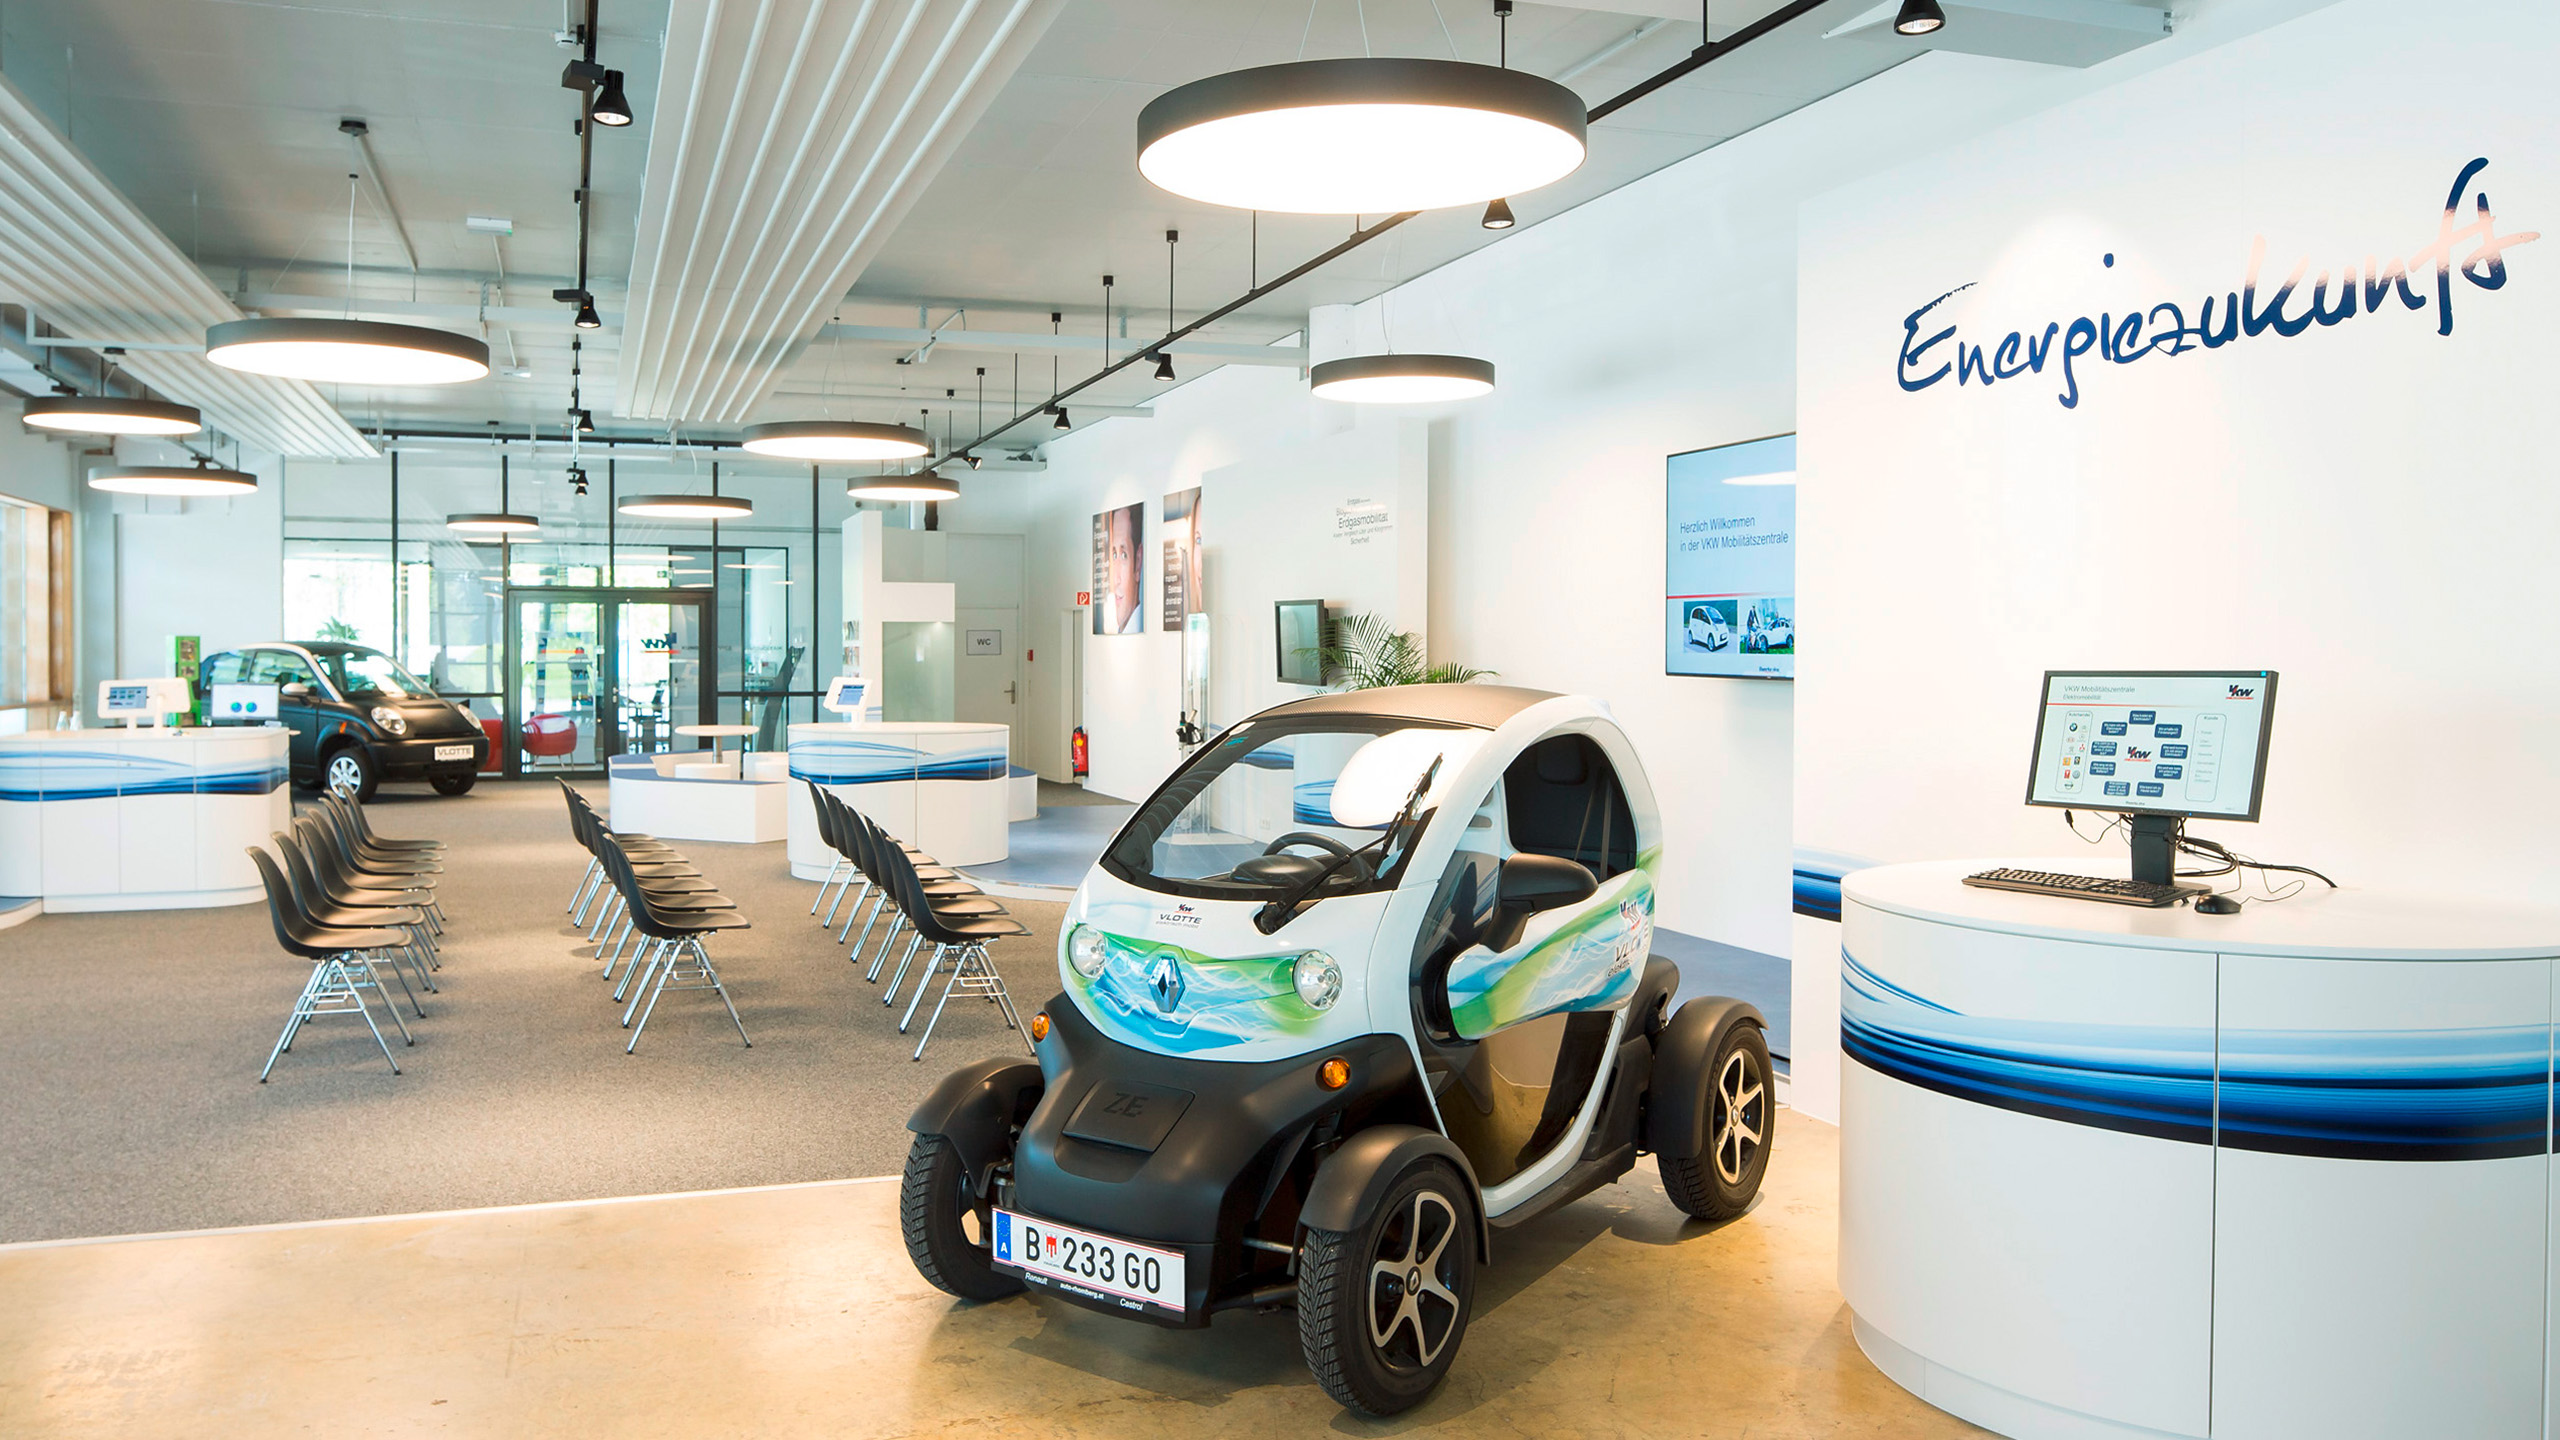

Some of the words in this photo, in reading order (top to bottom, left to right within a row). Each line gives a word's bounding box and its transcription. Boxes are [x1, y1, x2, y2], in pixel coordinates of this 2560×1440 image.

[1897, 157, 2541, 409] Energiezukunft
[1680, 521, 1709, 534] Herzlich
[1709, 516, 1755, 531] Willkommen
[1680, 540, 1687, 552] in
[1688, 538, 1700, 552] der
[1701, 537, 1720, 550] VKW
[1721, 531, 1789, 549] Mobilitätszentrale
[976, 638, 992, 646] WC
[437, 747, 472, 757] VLOTTE
[1160, 913, 1203, 925] VLOTTE
[1000, 1242, 1008, 1254] A
[1026, 1226, 1040, 1262] B
[1063, 1236, 1115, 1283] 233
[1125, 1252, 1161, 1294] GO
[1025, 1272, 1049, 1286] Renault
[1060, 1282, 1104, 1300] auto-rhomberg.at
[1120, 1298, 1144, 1311] Castrol
